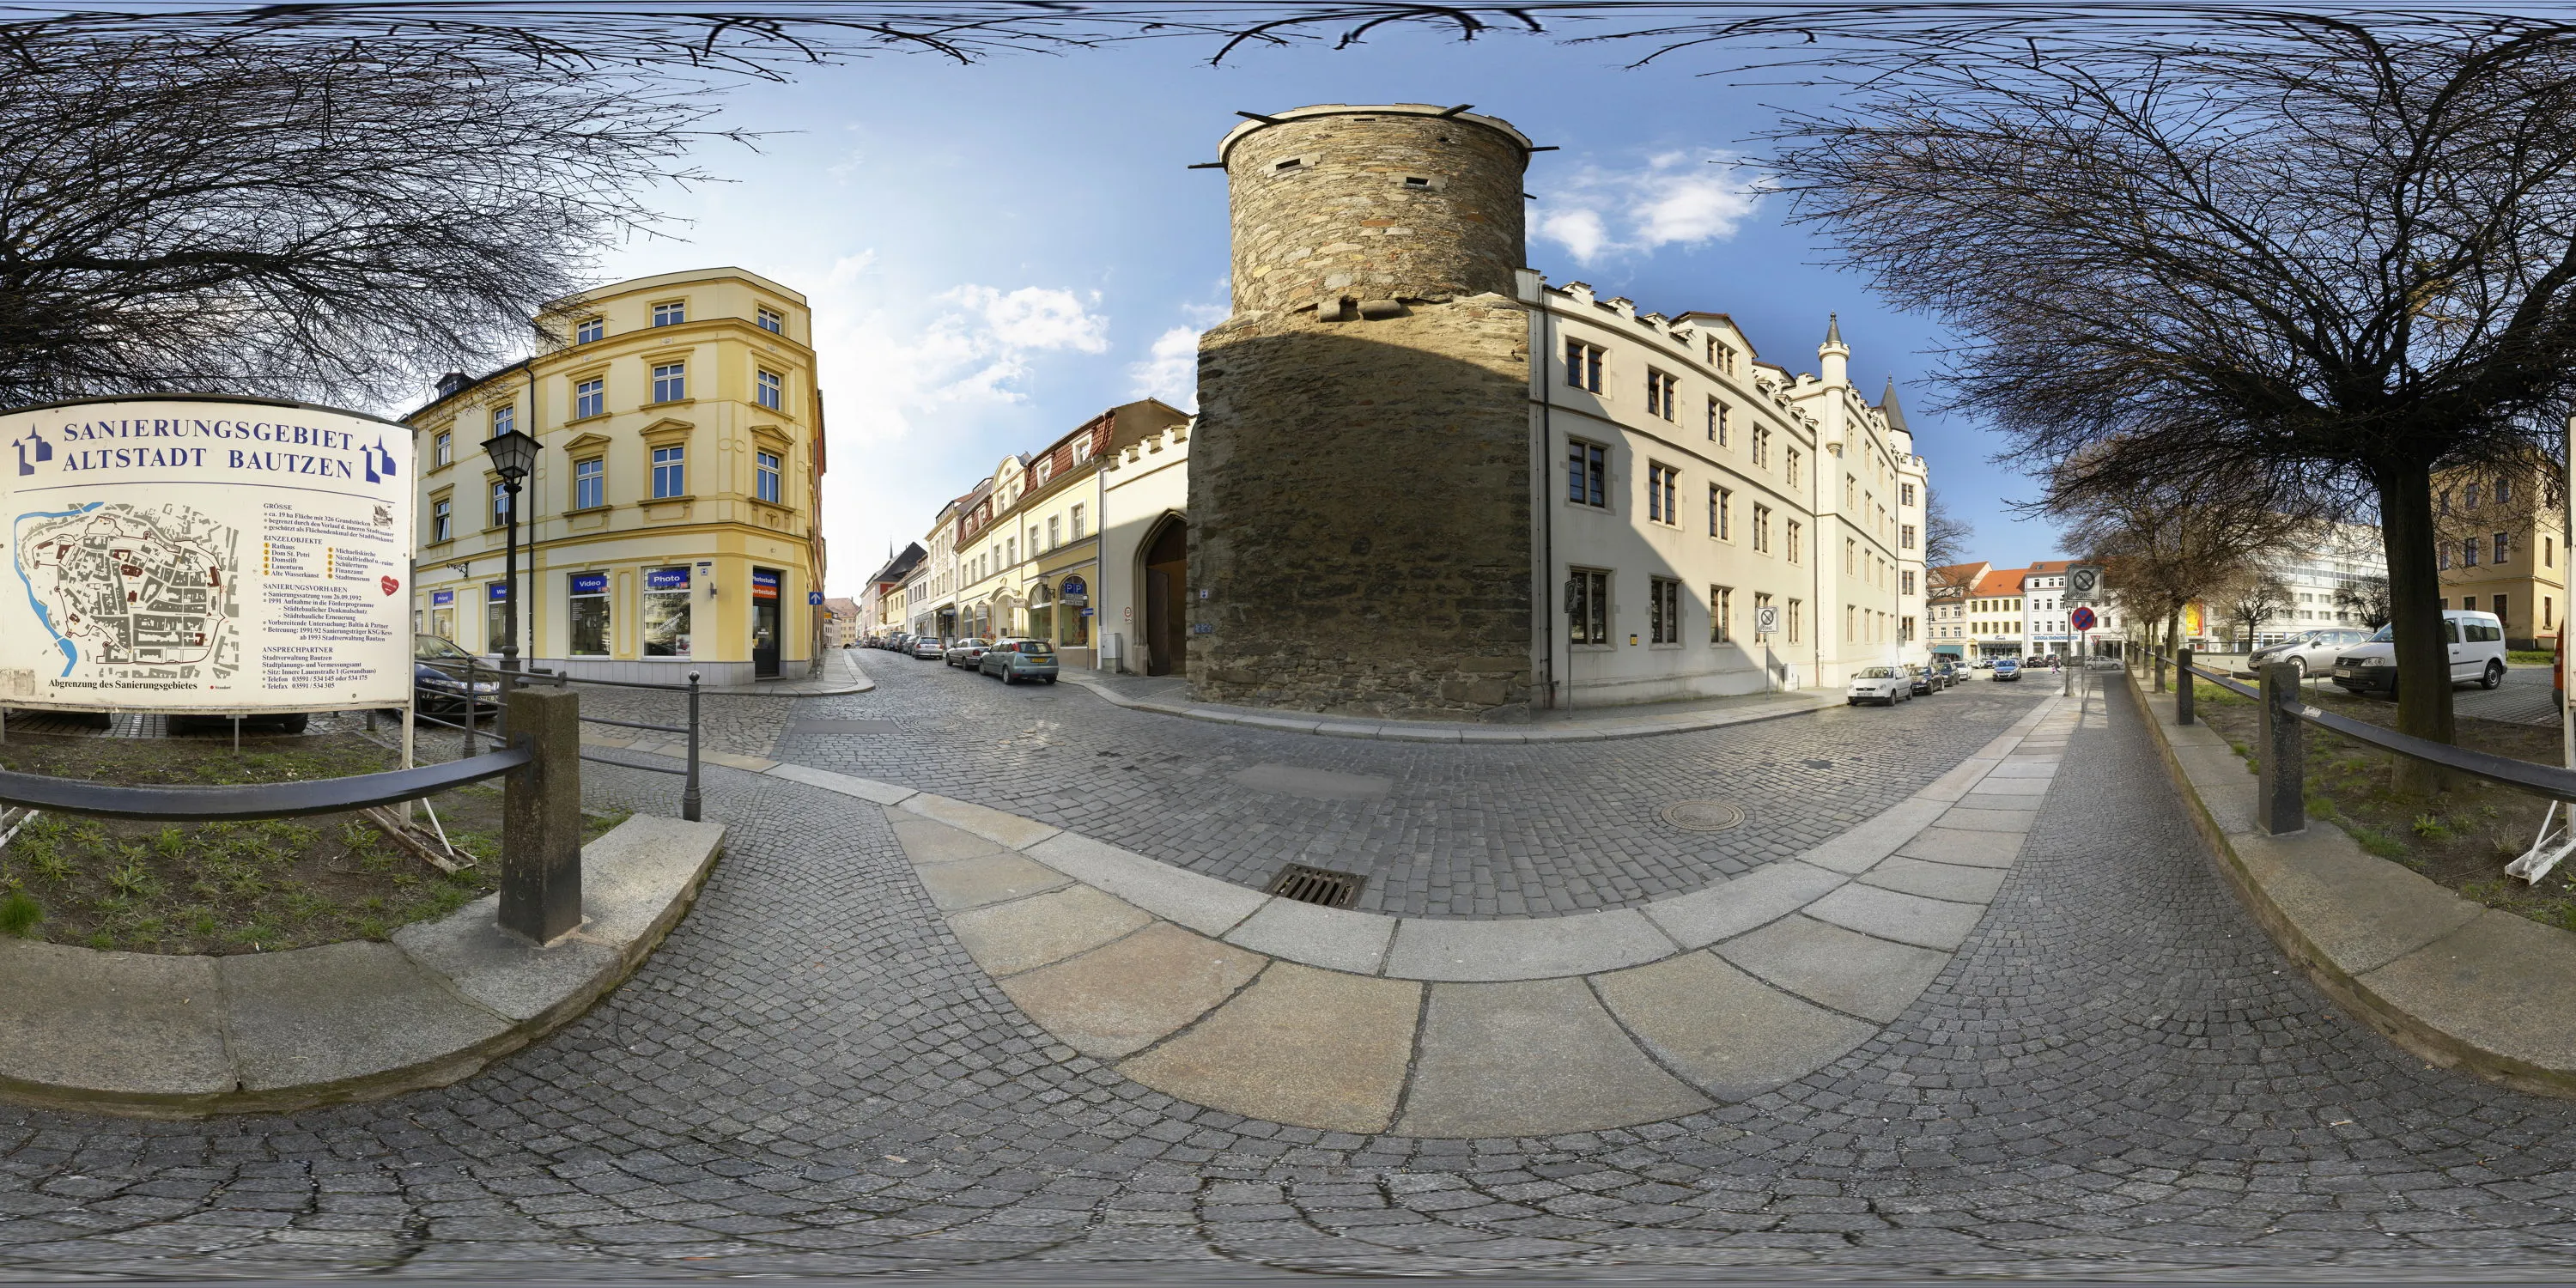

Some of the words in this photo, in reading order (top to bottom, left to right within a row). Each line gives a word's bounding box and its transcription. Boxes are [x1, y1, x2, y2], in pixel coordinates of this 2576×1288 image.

[64, 419, 353, 450] SANIERUNGSGEBIET
[62, 447, 207, 471] ALTSTADT
[228, 450, 352, 479] BAUTZEN
[335, 517, 370, 526] Grundstücken
[305, 527, 349, 536] Flächendenkmal
[359, 533, 394, 543] Stadtbaukunst
[366, 528, 394, 537] Stadtmauer
[264, 535, 323, 545] EINZELOBJEKTE
[336, 548, 376, 557] Michaeliskirche
[336, 555, 374, 563] Nicolaifriedhof
[263, 584, 347, 592] SANIERUNGSVORHABEN
[48, 679, 97, 690] Abgrenzung
[99, 680, 113, 688] des
[115, 680, 197, 691] Sanierungsgebietes
